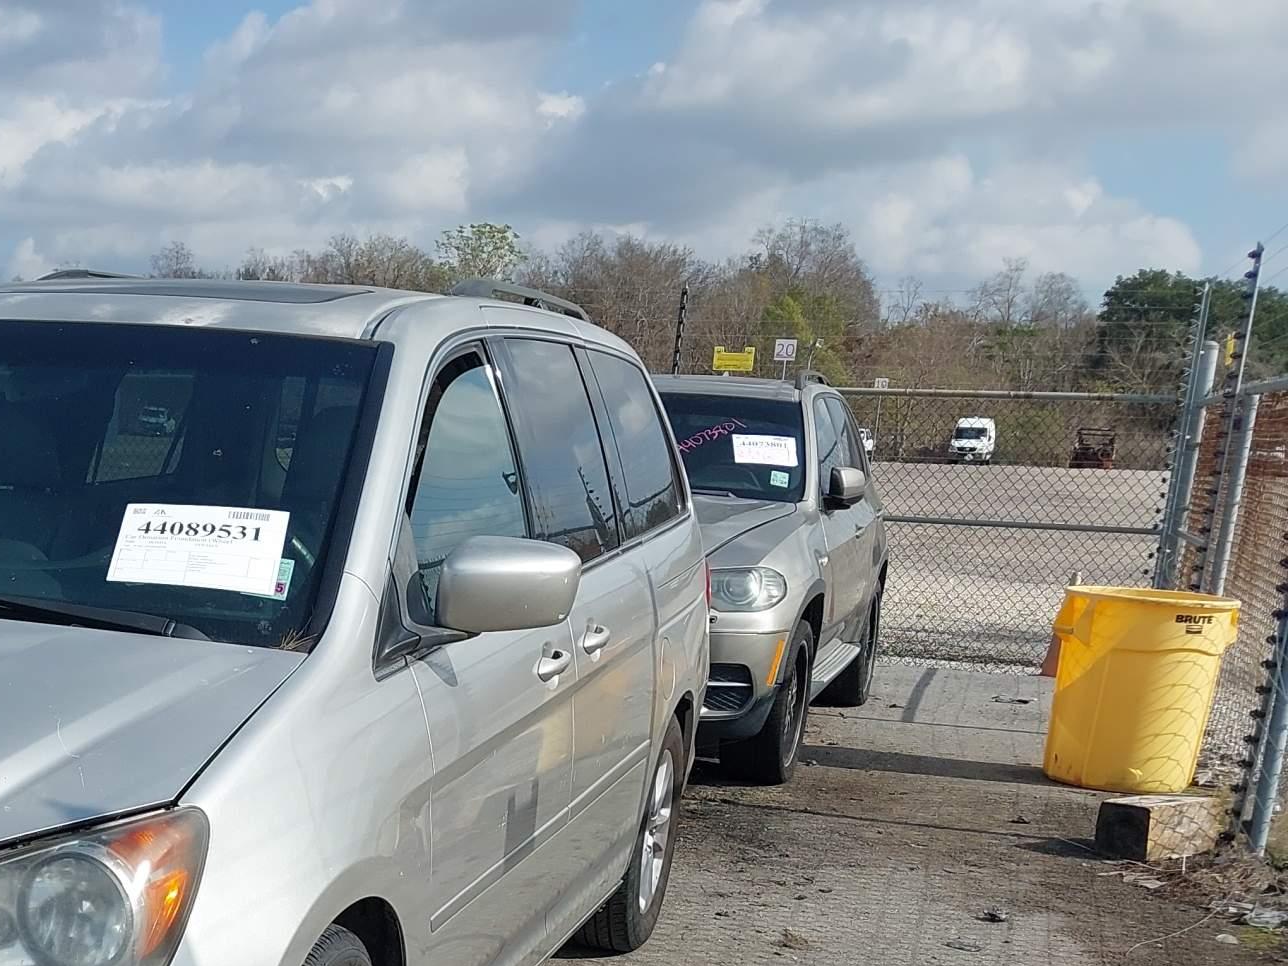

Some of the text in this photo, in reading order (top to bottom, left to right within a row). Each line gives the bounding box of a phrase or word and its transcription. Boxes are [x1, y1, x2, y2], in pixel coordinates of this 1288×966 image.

[776, 343, 795, 357] 20
[137, 521, 262, 542] 44089531
[1175, 614, 1215, 625] BRUTE
